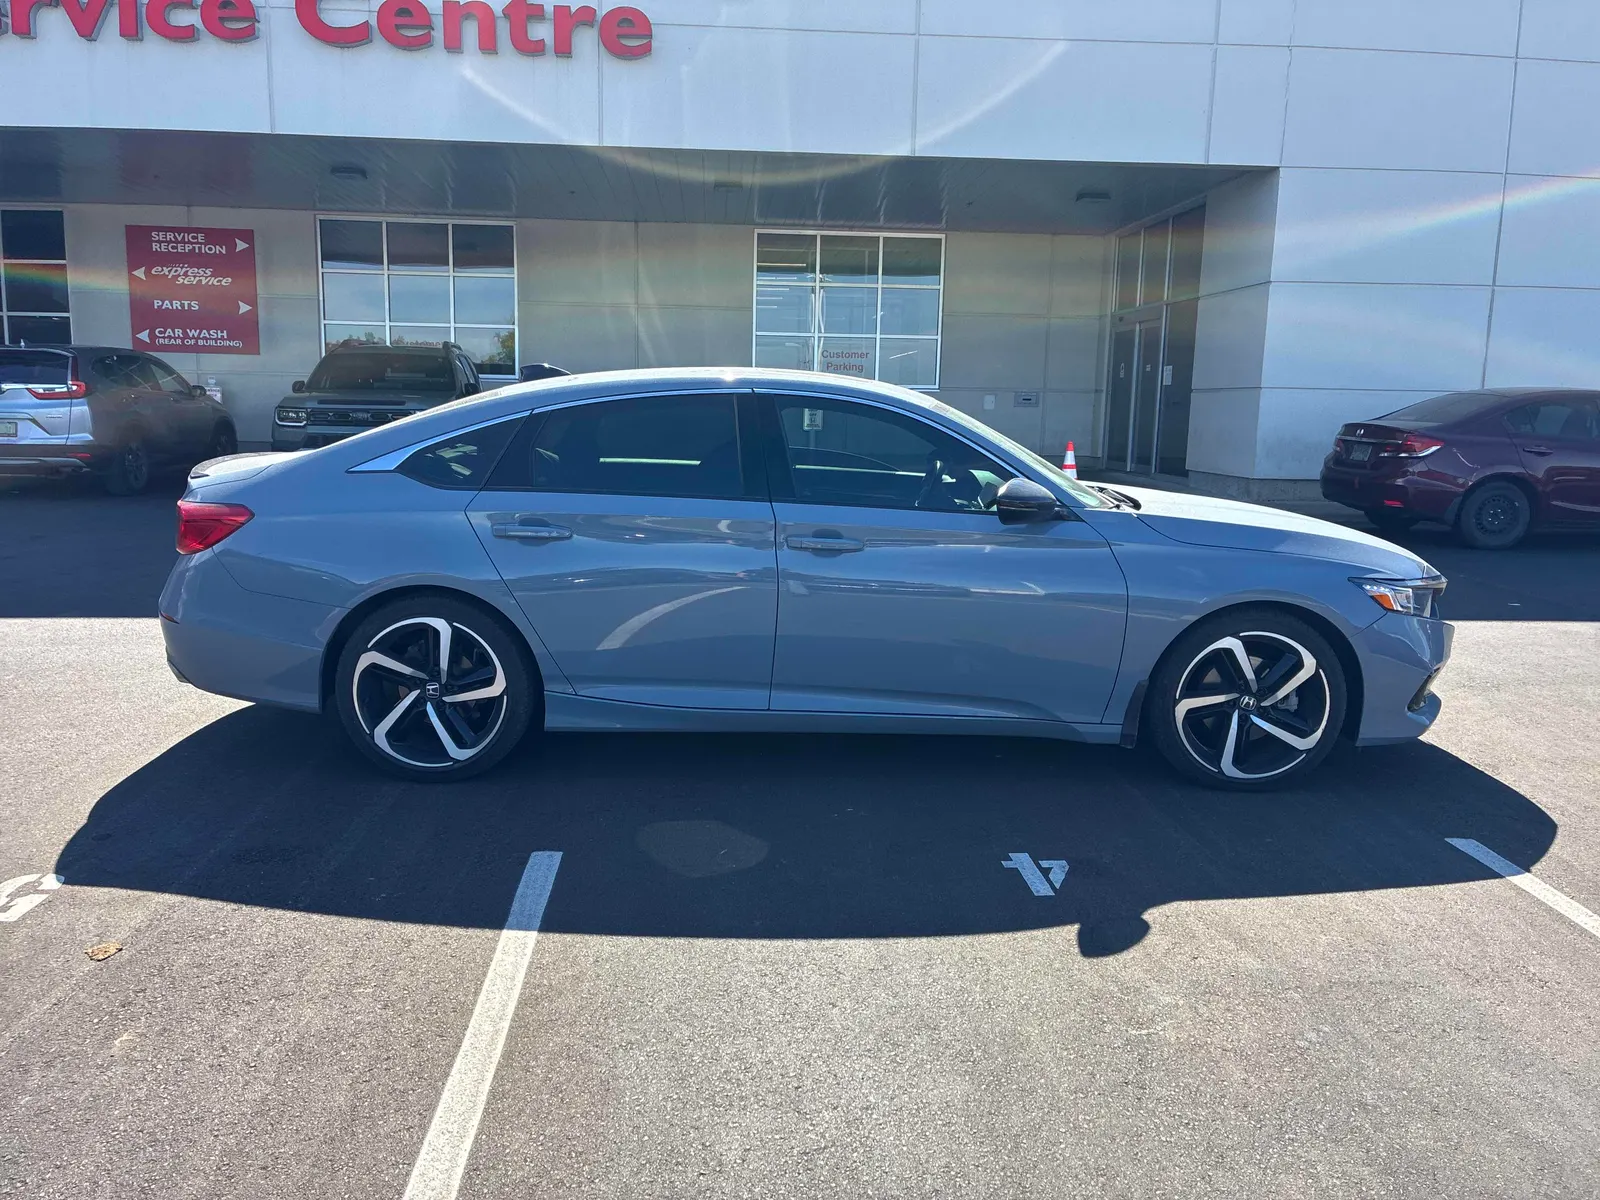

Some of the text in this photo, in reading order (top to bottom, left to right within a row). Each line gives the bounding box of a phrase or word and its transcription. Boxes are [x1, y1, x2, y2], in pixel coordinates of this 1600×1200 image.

[0, 0, 654, 60] rvice Centre
[151, 231, 206, 243] SERVICE
[152, 242, 227, 255] RECEPTION
[151, 265, 213, 278] express
[175, 275, 232, 286] service
[153, 299, 200, 311] PARTS
[155, 328, 228, 339] CAR WASH
[155, 338, 182, 346] (REAR
[197, 339, 243, 348] BUILDING)
[821, 349, 870, 359] Customer
[826, 361, 864, 373] Parking
